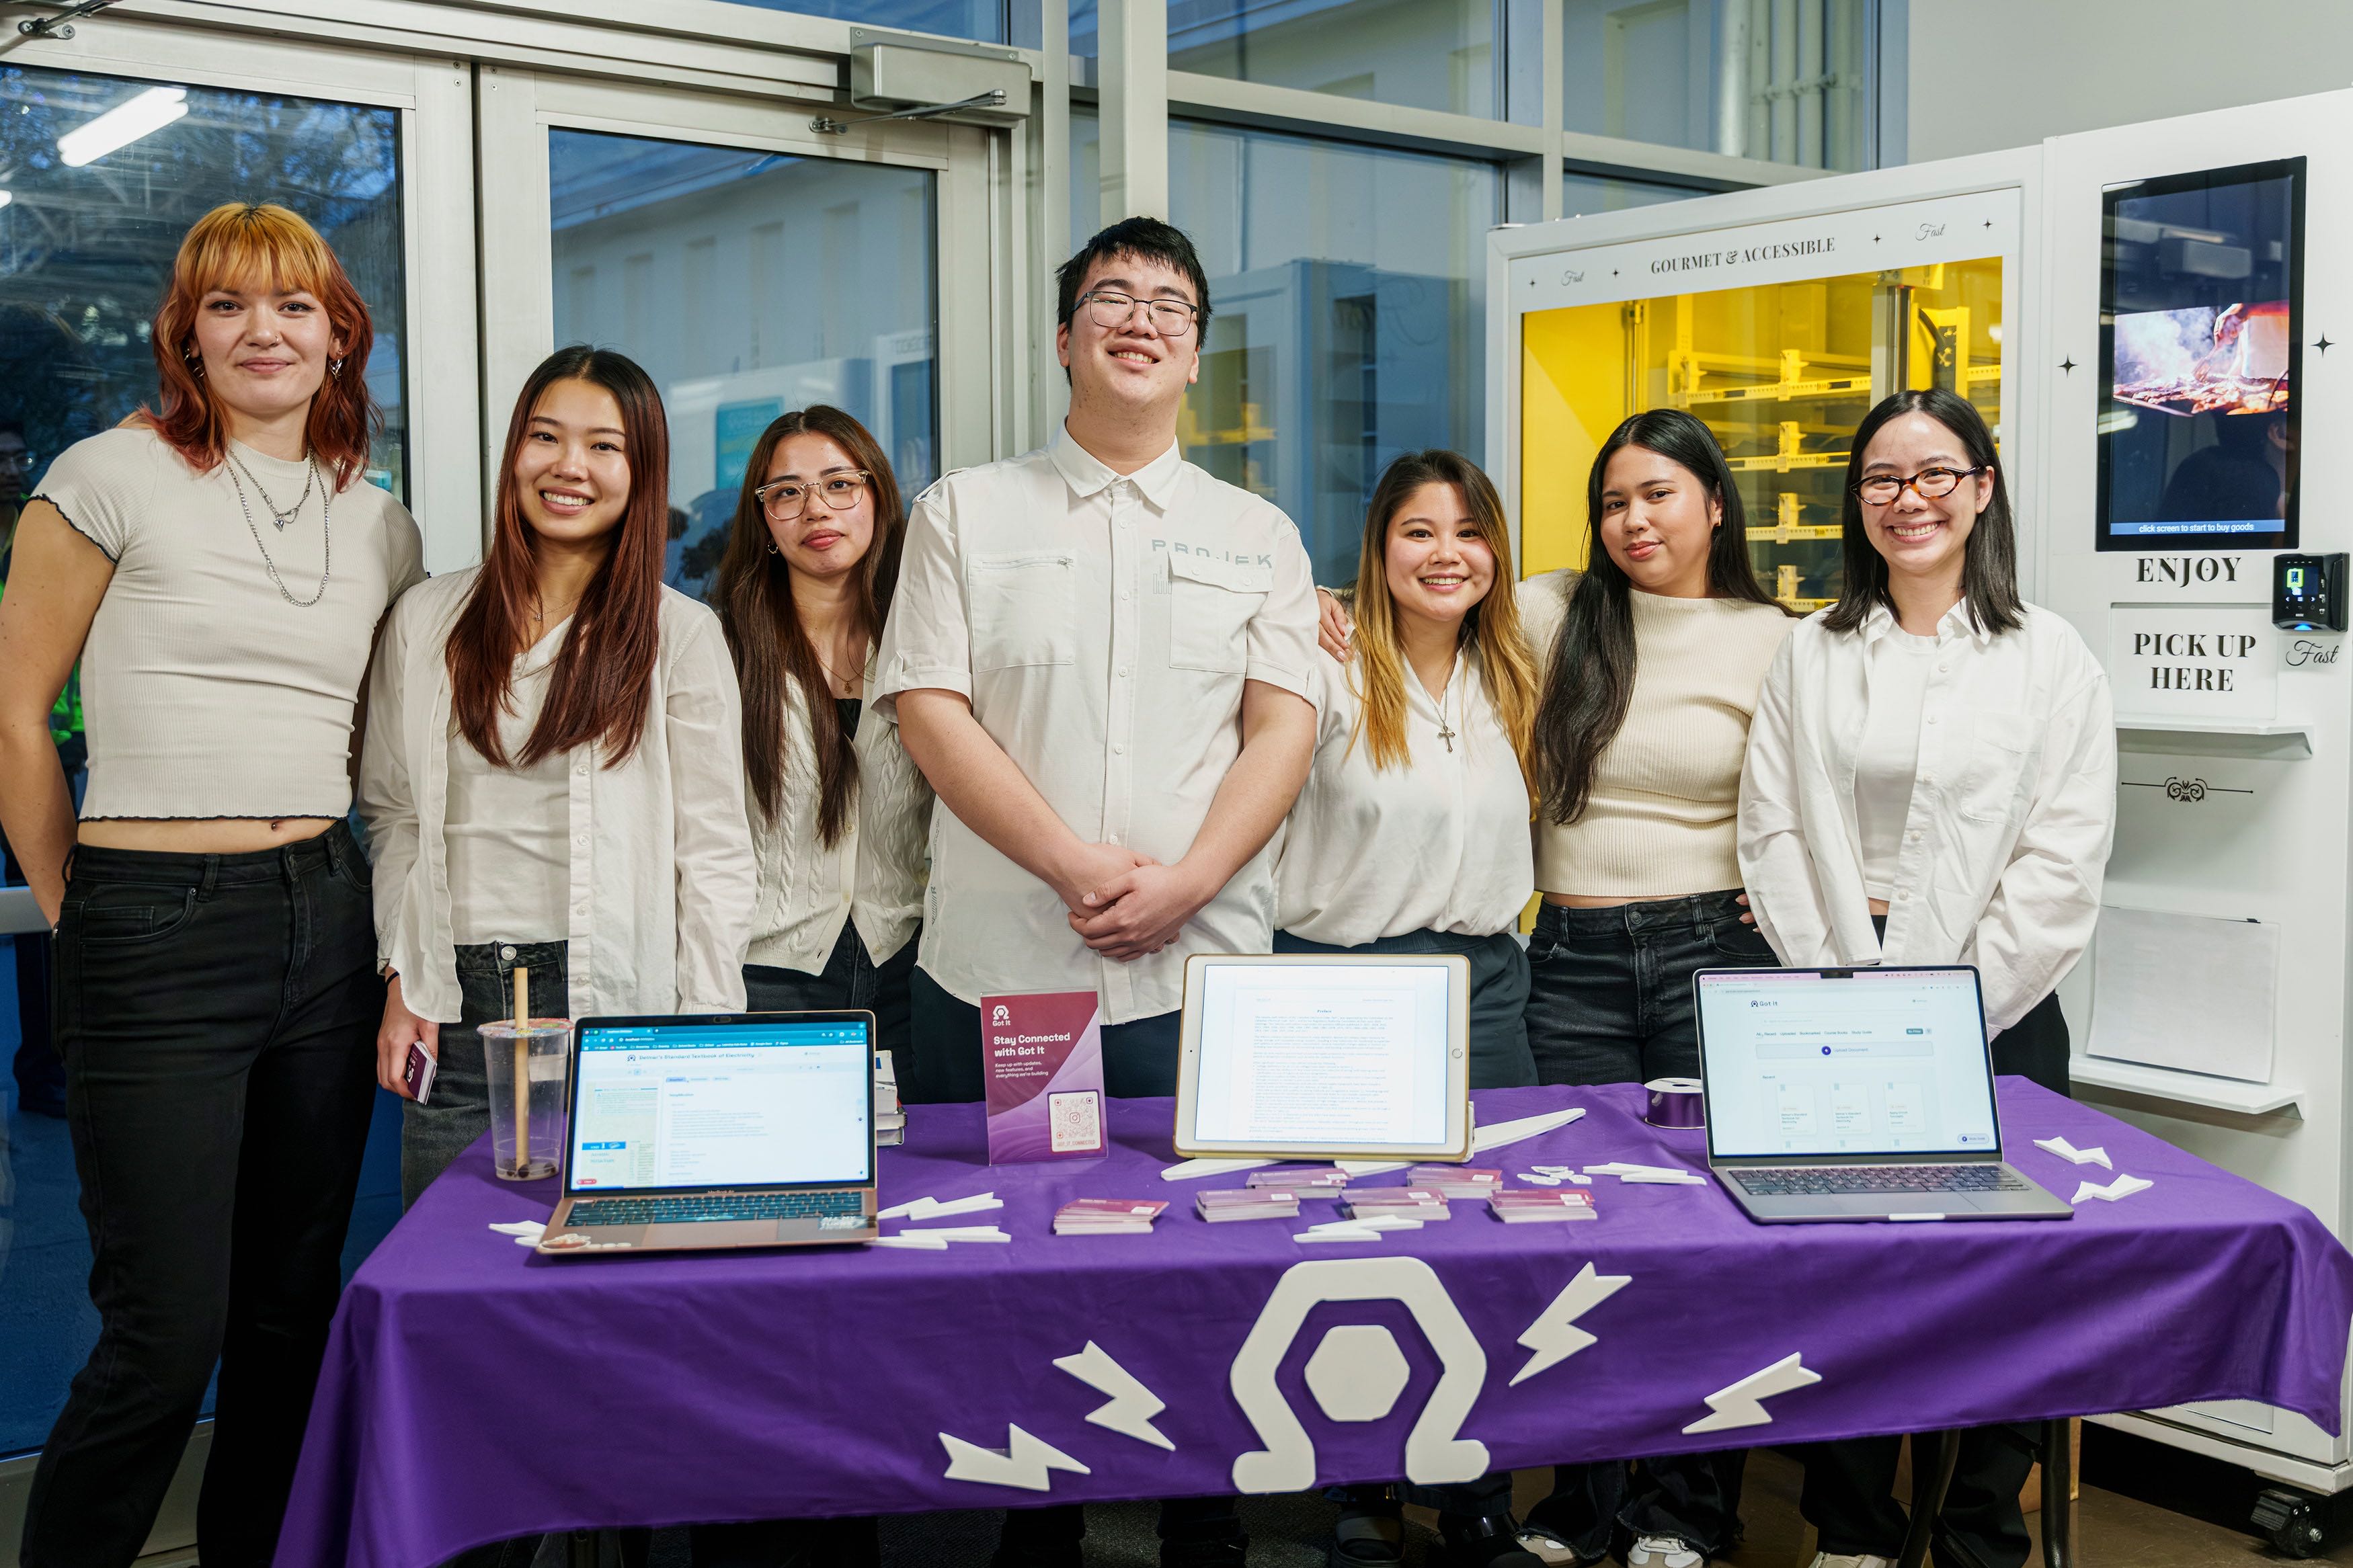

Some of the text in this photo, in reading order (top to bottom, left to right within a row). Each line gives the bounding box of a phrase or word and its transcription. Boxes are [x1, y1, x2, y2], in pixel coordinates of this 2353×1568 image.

[1915, 222, 1946, 241] Fast
[1650, 237, 1835, 274] GOURMET & ACCESSIBLE
[1560, 270, 1585, 286] Fast
[2139, 524, 2155, 532] click
[2180, 524, 2189, 532] to
[2216, 524, 2230, 533] buy
[2231, 523, 2254, 532] goods
[2136, 556, 2241, 588] ENJOY
[2132, 632, 2257, 659] PICK UP
[2285, 639, 2340, 667] Fast
[2149, 667, 2234, 692] HERE
[993, 1032, 1070, 1046] Stay Connected
[994, 1046, 1045, 1057] with Got It
